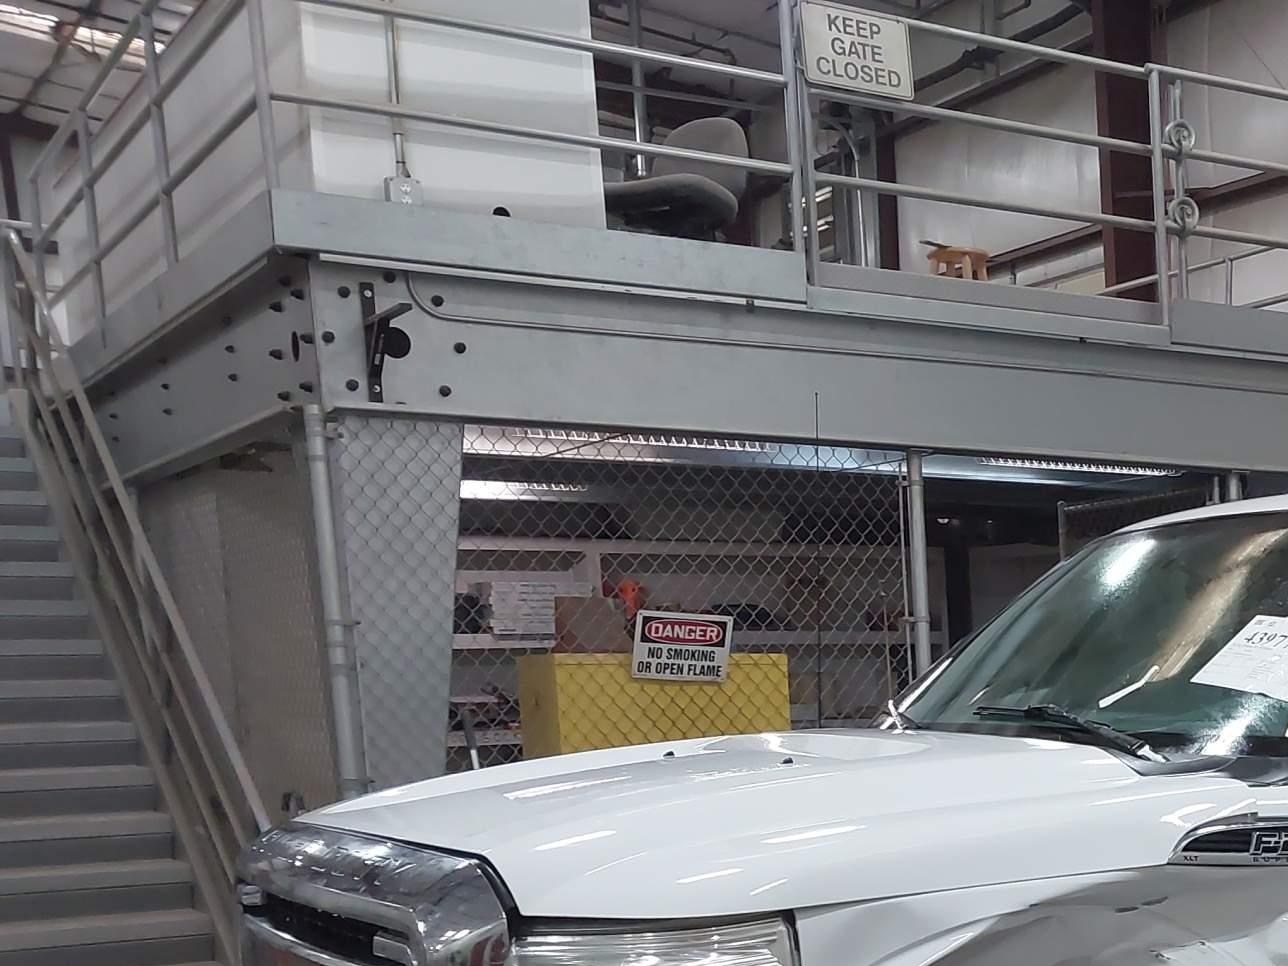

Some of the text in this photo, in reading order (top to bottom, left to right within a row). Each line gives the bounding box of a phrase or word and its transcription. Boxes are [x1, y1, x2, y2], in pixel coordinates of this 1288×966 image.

[826, 13, 882, 40] KEEP
[830, 37, 884, 64] GATE
[816, 56, 901, 88] CLOSED
[650, 623, 718, 641] DANGER
[647, 646, 716, 662] NO SMOKING
[637, 661, 723, 678] OR OPEN FLAME
[1183, 855, 1200, 863] XLT
